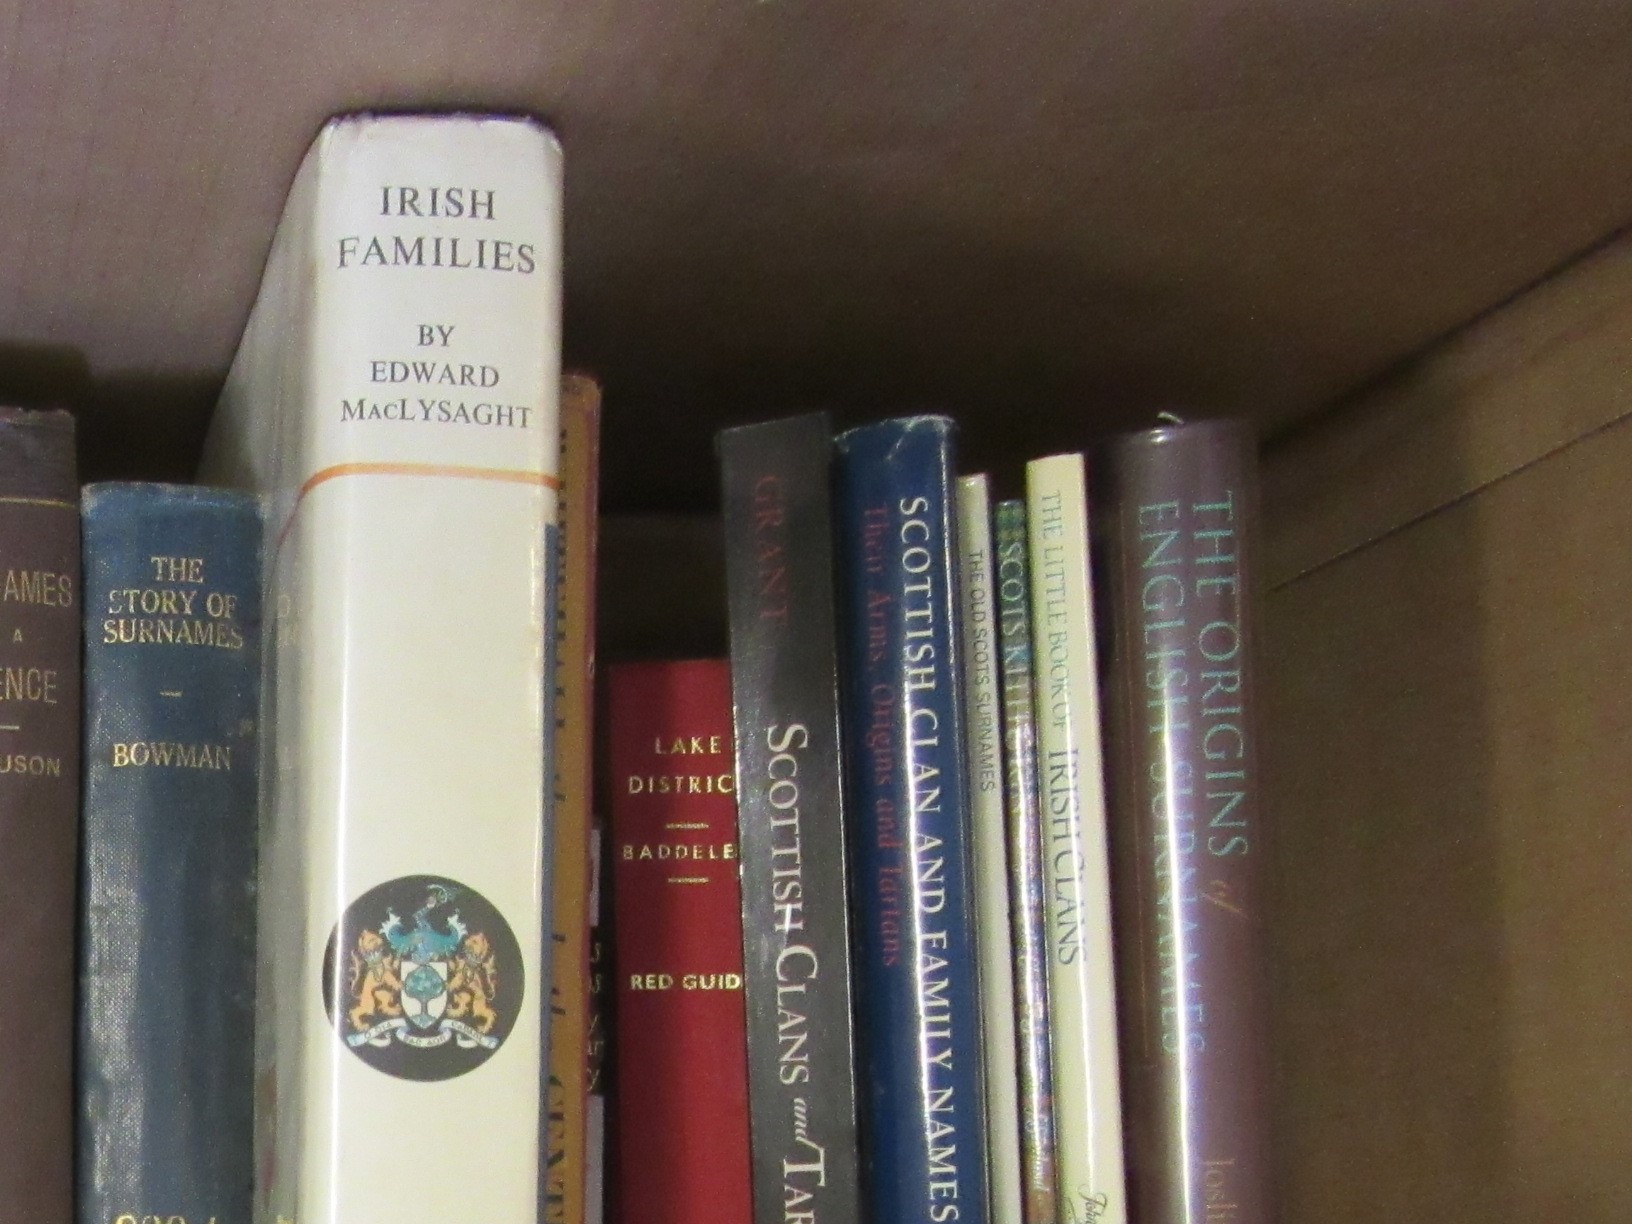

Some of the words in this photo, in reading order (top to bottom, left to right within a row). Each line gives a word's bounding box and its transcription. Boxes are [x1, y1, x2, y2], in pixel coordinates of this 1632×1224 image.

[380, 185, 497, 221] IRISH
[337, 235, 536, 275] FAMILIES
[418, 324, 455, 347] BY
[370, 360, 500, 388] EDWARD
[1041, 489, 1063, 540] THE
[969, 549, 984, 582] THE
[1192, 490, 1236, 597] THE
[150, 556, 204, 584] THE
[900, 496, 936, 691] SCOTTISH
[998, 541, 1026, 637] SCOTS
[1045, 545, 1067, 626] LITTLE
[108, 589, 192, 616] STORY
[206, 593, 237, 620] OF
[970, 589, 986, 622] OLD
[1138, 500, 1191, 733] ENGLISH
[12, 627, 24, 644] A
[103, 618, 245, 650] SURNAMES
[973, 627, 990, 686] SCOTS
[1048, 630, 1071, 699] BOOK
[113, 742, 232, 771] BOWMAN
[654, 735, 722, 756] LAKE
[910, 707, 941, 812] CLAN
[976, 691, 996, 793] SURNAMES
[1199, 621, 1249, 856] ORIGINS
[628, 775, 735, 795] DISTRIC
[1048, 748, 1080, 843] IRISH
[767, 722, 809, 932] SCOTTISH
[876, 797, 903, 848] and
[623, 843, 738, 861] BADDELE
[916, 832, 945, 914] AND
[1053, 849, 1087, 965] CLANS
[630, 974, 673, 991] RED
[682, 973, 743, 991] GUID
[919, 930, 954, 1071] FAMILY
[775, 944, 818, 1085] CLANS
[794, 1097, 823, 1149] and
[925, 1086, 959, 1223] NAMES
